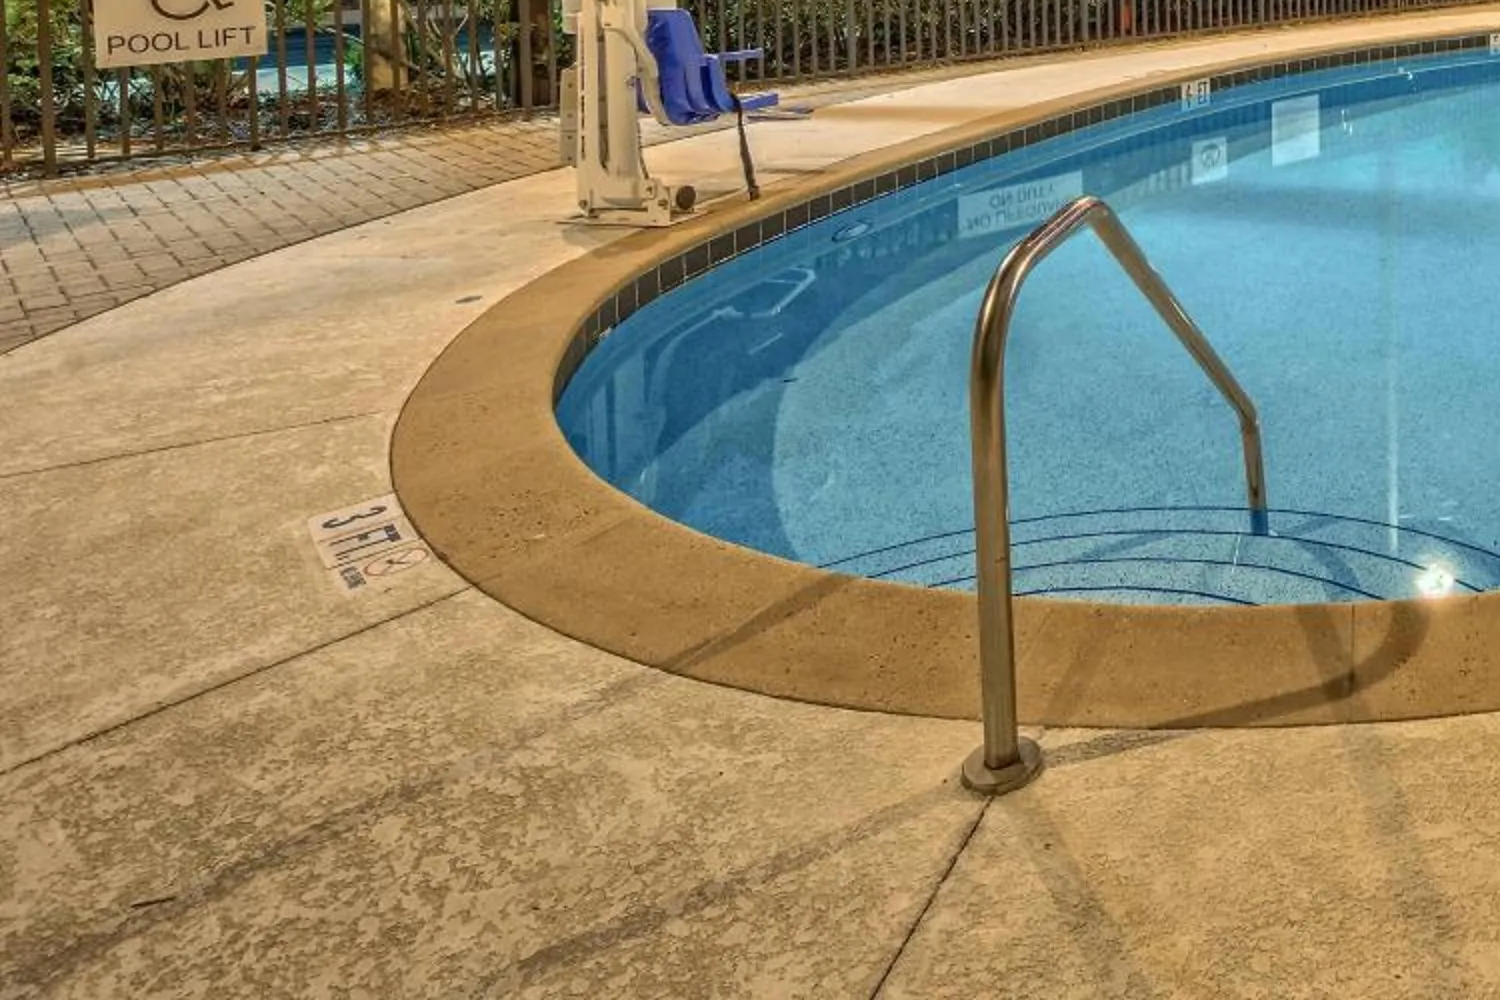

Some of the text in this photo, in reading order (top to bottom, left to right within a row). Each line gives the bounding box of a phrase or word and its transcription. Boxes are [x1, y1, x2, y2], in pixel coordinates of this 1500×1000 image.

[107, 26, 256, 55] POOL LIFT
[321, 505, 387, 528] 3
